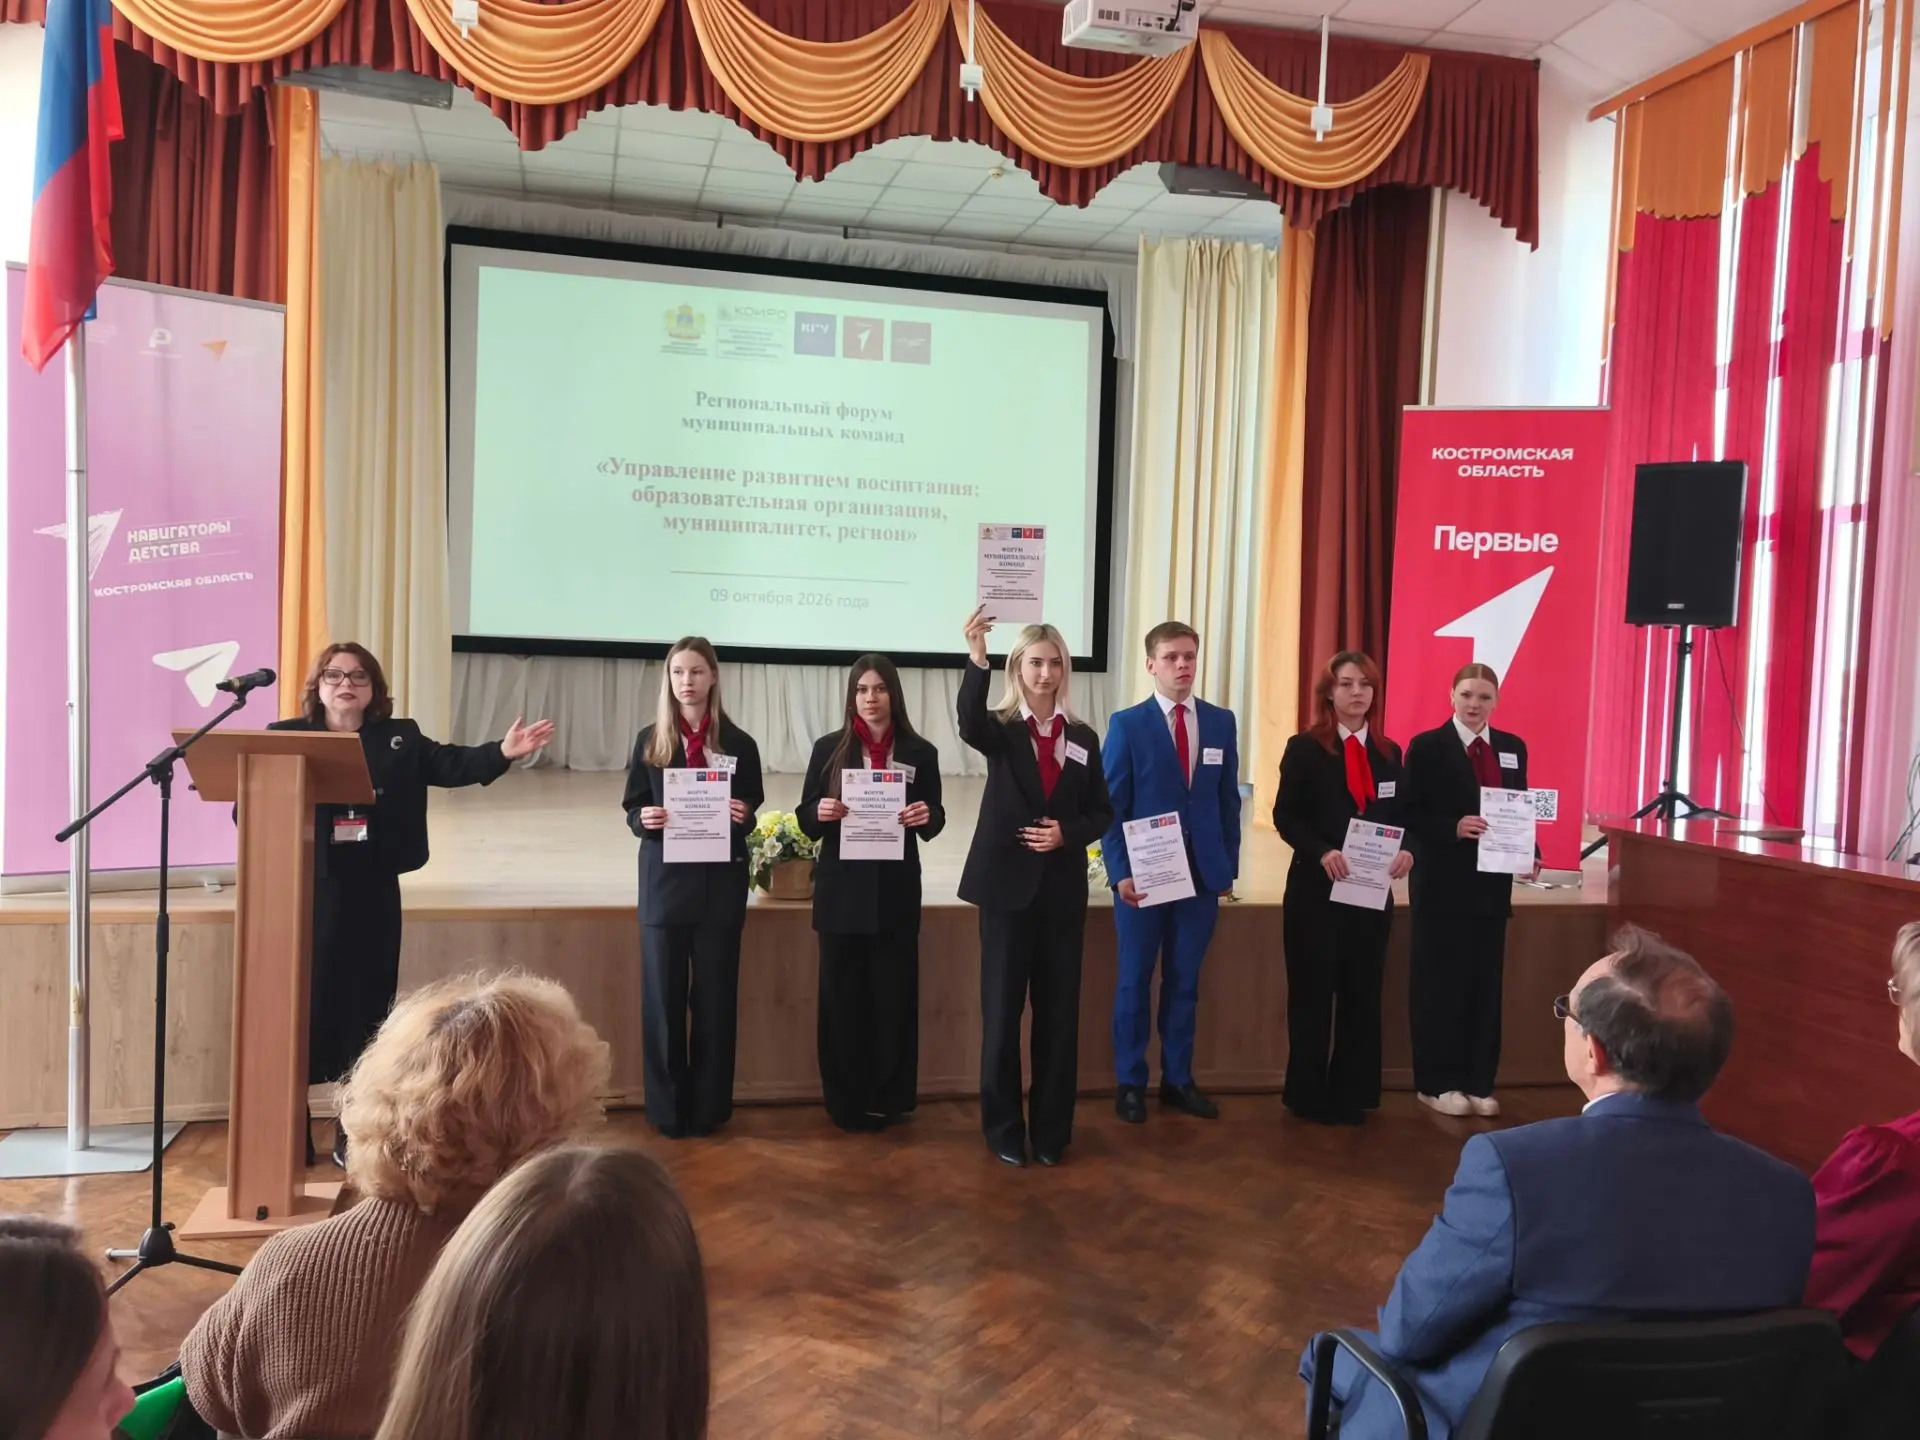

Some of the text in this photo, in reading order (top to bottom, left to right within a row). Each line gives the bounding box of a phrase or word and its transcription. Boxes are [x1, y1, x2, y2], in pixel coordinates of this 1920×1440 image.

[695, 391, 893, 423] Региональный форум
[681, 416, 905, 444] муниципальных команд
[1431, 447, 1574, 460] КОСТРОМСКАЯ
[596, 457, 980, 497] «Управление развитием воспитания:
[1457, 464, 1545, 478] ОБЛАСТЬ
[632, 485, 948, 521] образовательная организация,
[127, 520, 231, 544] НАВИГАТОРЫ
[663, 516, 918, 543] муниципалитет, регион»
[1434, 525, 1559, 559] Первые
[128, 541, 200, 563] ДЕТСТВА
[93, 572, 254, 597] КОСТРОМСКАЯ ОБЛАСТЬ
[710, 588, 728, 602] 09
[732, 590, 793, 605] октября
[837, 596, 869, 610] года
